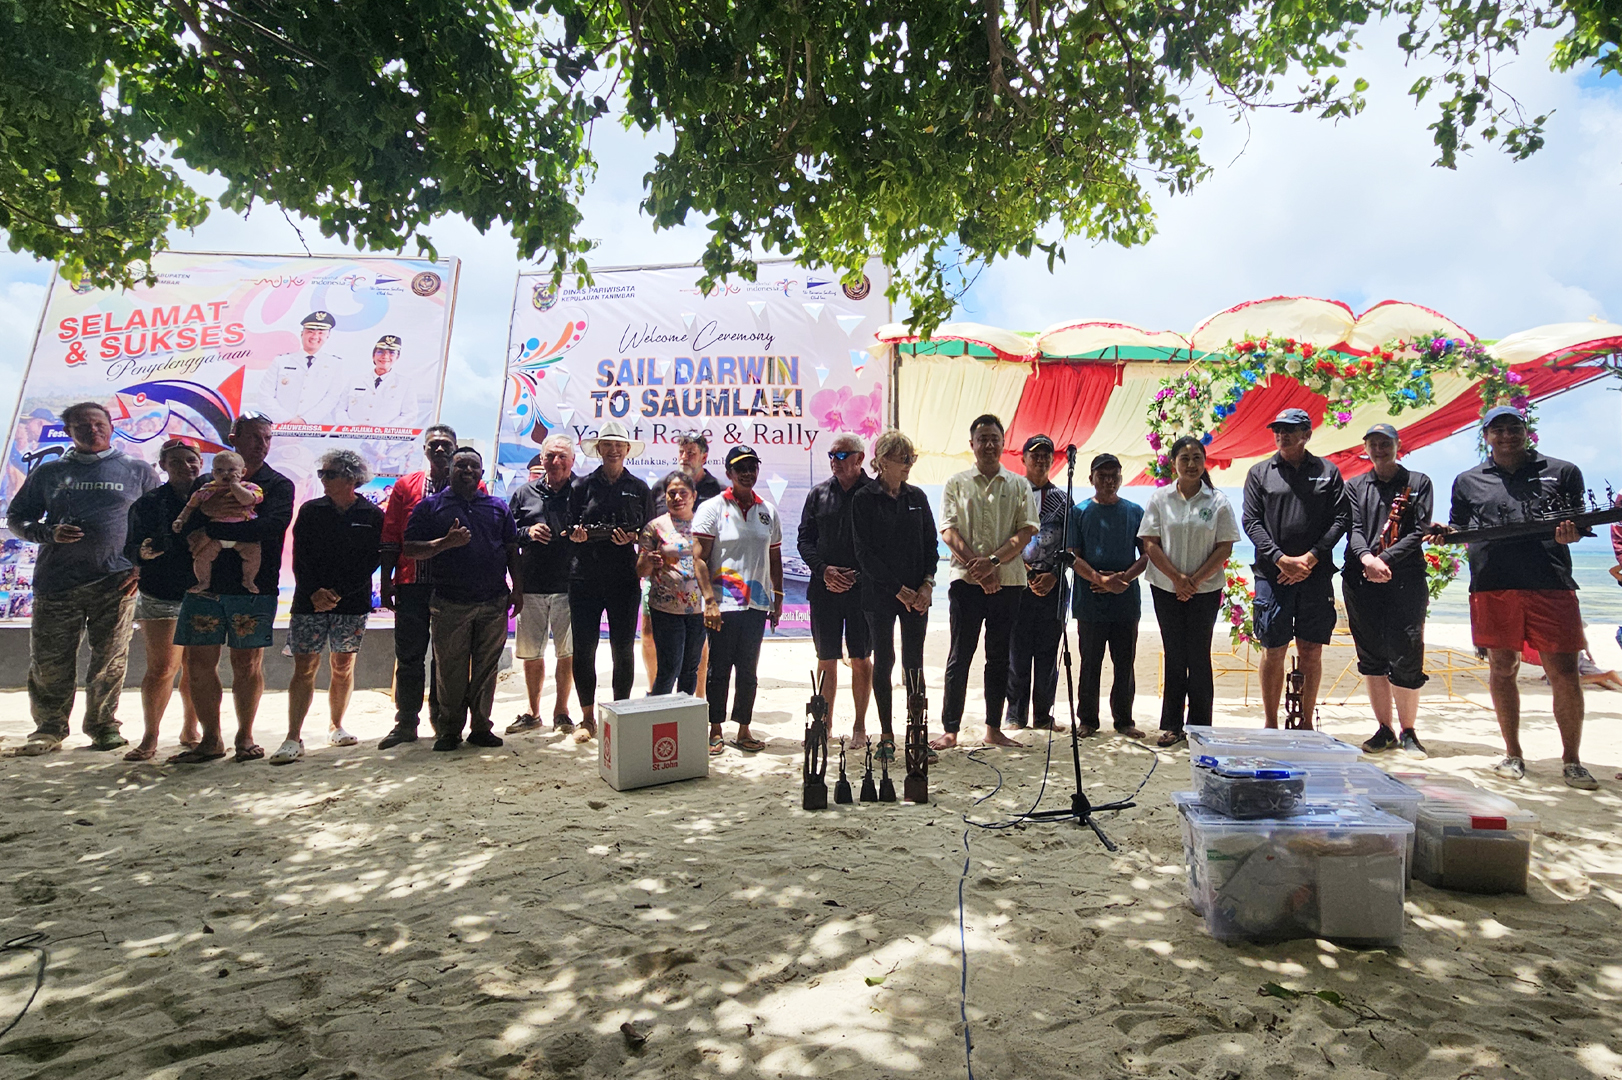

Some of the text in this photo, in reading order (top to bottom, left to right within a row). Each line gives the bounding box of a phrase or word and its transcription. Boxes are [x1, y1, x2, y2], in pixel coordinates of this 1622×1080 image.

[561, 292, 636, 302] KEPULAUAN TANIMBAR
[562, 285, 636, 296] DINAS PARIWISATA
[58, 301, 229, 343] SELAMAT
[618, 320, 775, 354] Welcome Ceremony
[64, 322, 247, 367] & SUKSES
[106, 349, 253, 381] Penyelenggaraan
[595, 355, 800, 388] SAIL DARWIN
[589, 387, 805, 418] TO SAUMLAKI
[572, 422, 820, 451] Yat Rae & Rally
[652, 760, 678, 771] St John
